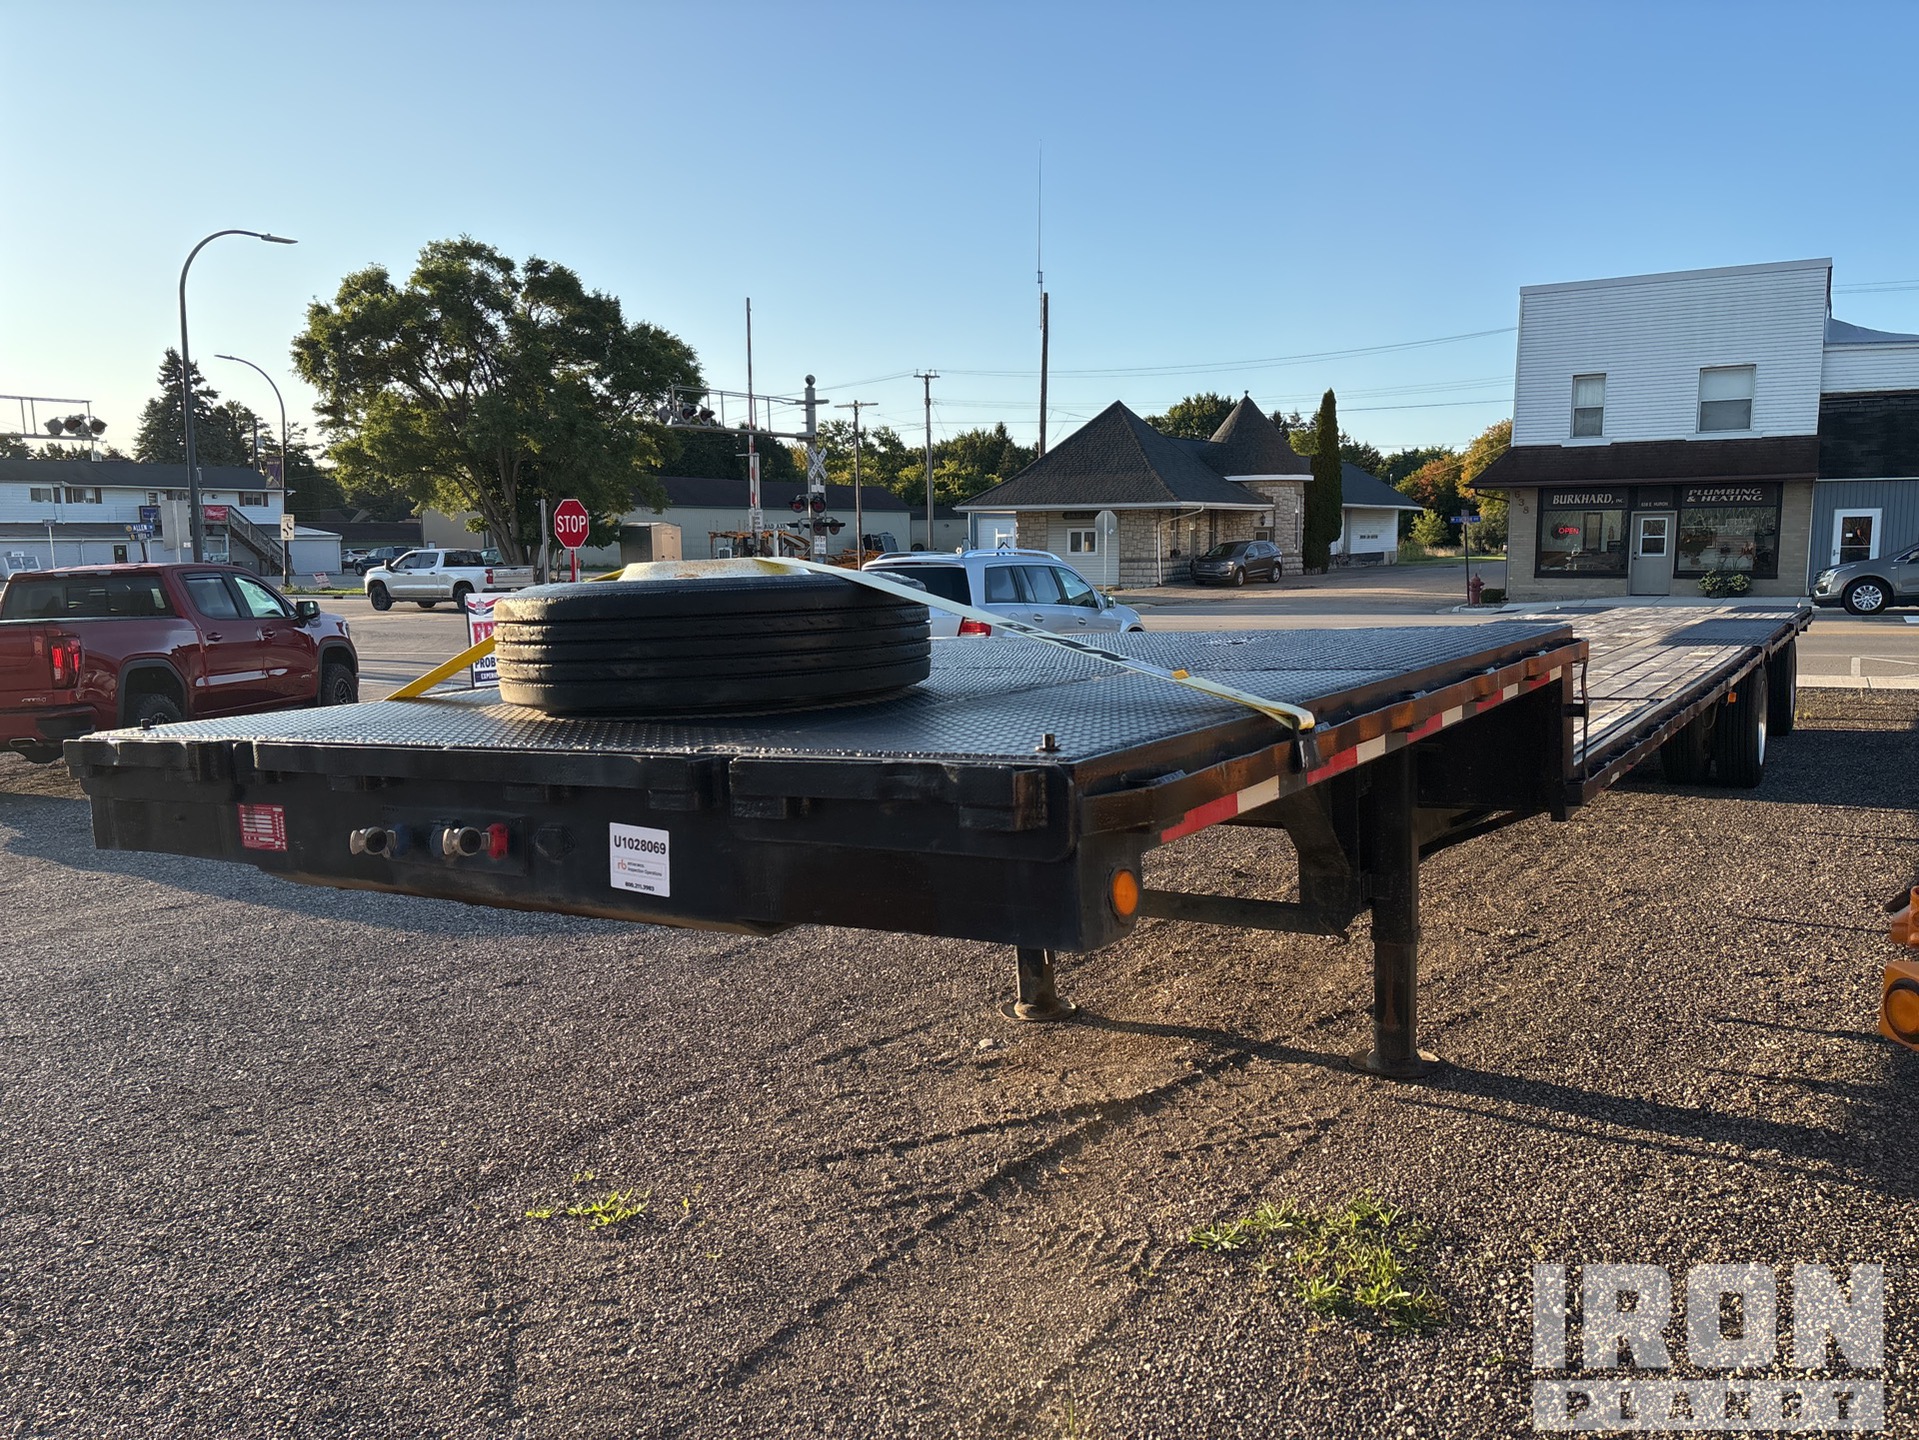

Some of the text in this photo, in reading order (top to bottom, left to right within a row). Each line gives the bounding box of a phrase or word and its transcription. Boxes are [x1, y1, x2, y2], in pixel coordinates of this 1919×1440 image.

[1688, 488, 1761, 496] PLUMBING
[1552, 493, 1614, 505] BURKHARD,
[1686, 494, 1763, 503] & HEATING
[557, 515, 587, 533] STOP
[1558, 527, 1580, 535] OPEN
[475, 657, 496, 668] PROB
[614, 835, 666, 855] U1028069
[617, 859, 627, 870] rb
